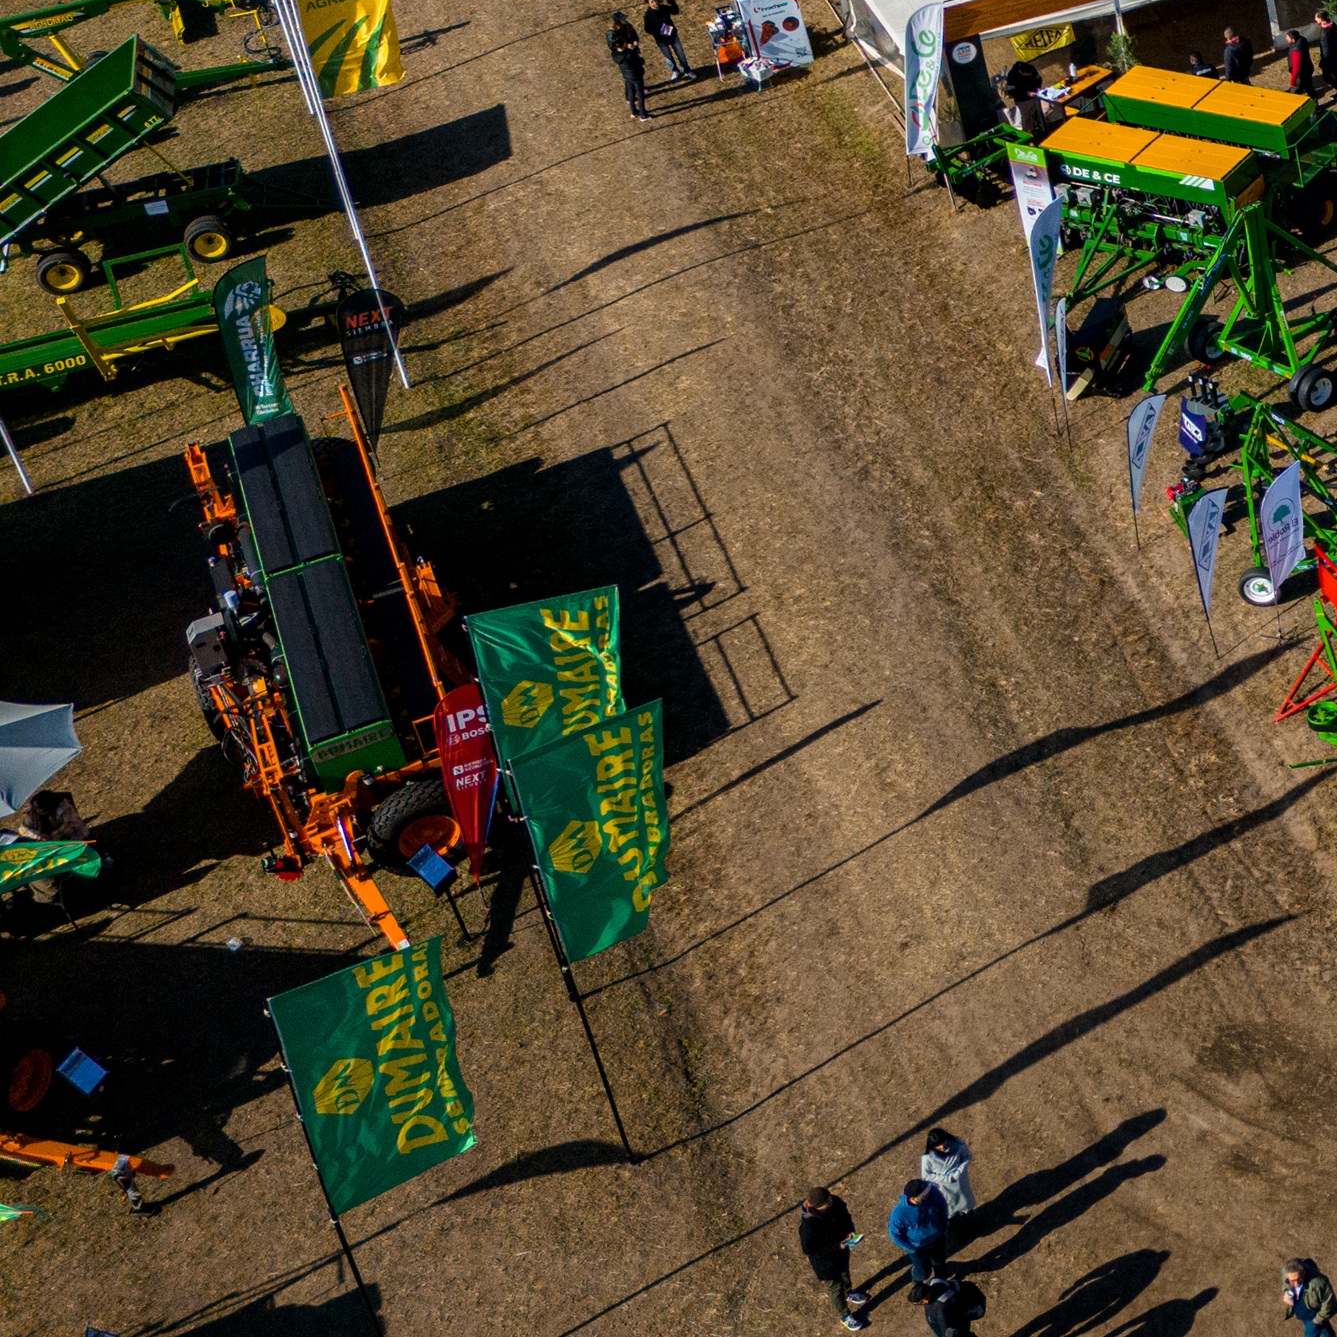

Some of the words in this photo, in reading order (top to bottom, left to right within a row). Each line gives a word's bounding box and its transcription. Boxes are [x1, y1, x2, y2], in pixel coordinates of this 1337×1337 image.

[1072, 167, 1090, 178] DE
[1093, 169, 1101, 179] &
[1103, 173, 1121, 184] CE
[345, 306, 394, 329] NEXT
[43, 354, 87, 376] 6000
[236, 315, 264, 397] CHARRUA
[454, 771, 487, 789] NEXT
[361, 953, 450, 1154] DUMAIRE
